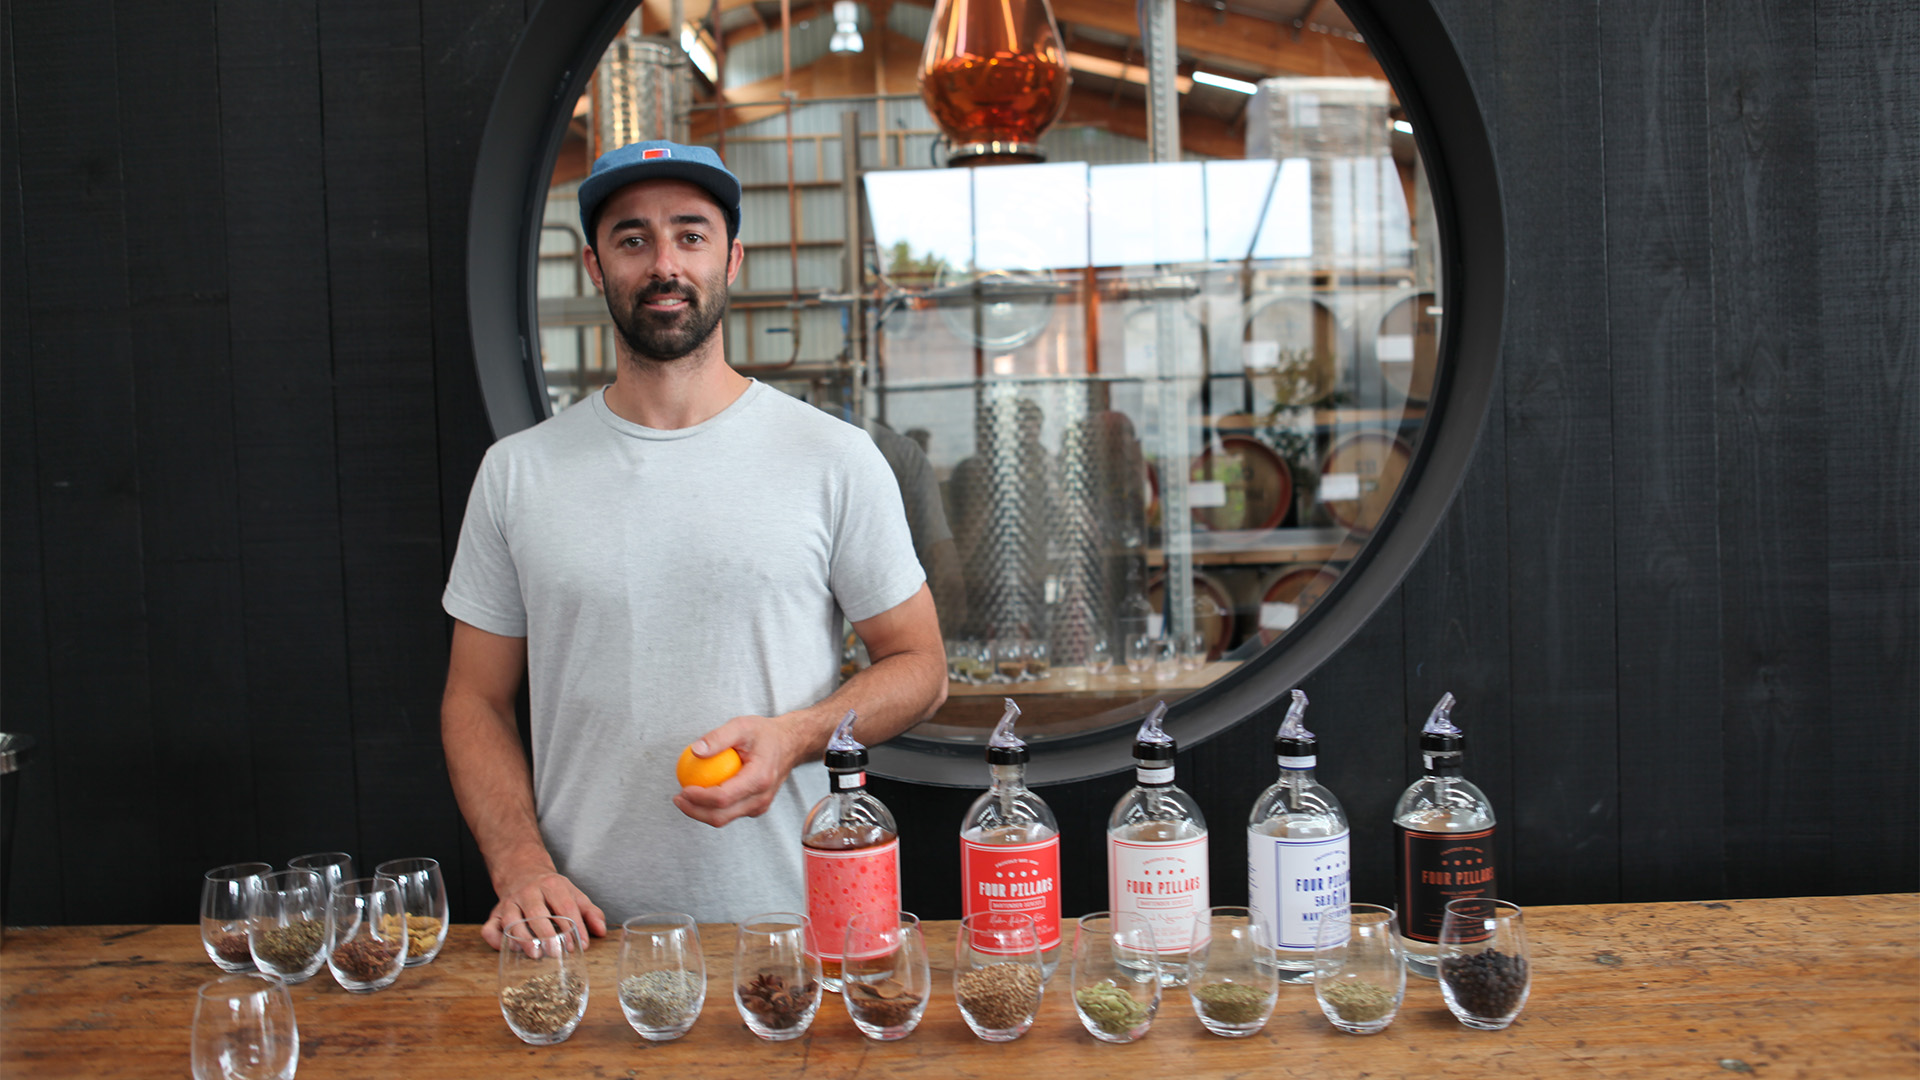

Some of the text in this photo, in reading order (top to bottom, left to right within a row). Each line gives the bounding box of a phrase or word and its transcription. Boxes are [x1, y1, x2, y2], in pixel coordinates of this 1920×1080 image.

[1296, 878, 1324, 891] FOUR
[1422, 866, 1494, 885] FOUR PILLARS
[979, 877, 1053, 897] FOUR PILLARS
[1126, 876, 1200, 895] FOUR PILLARS
